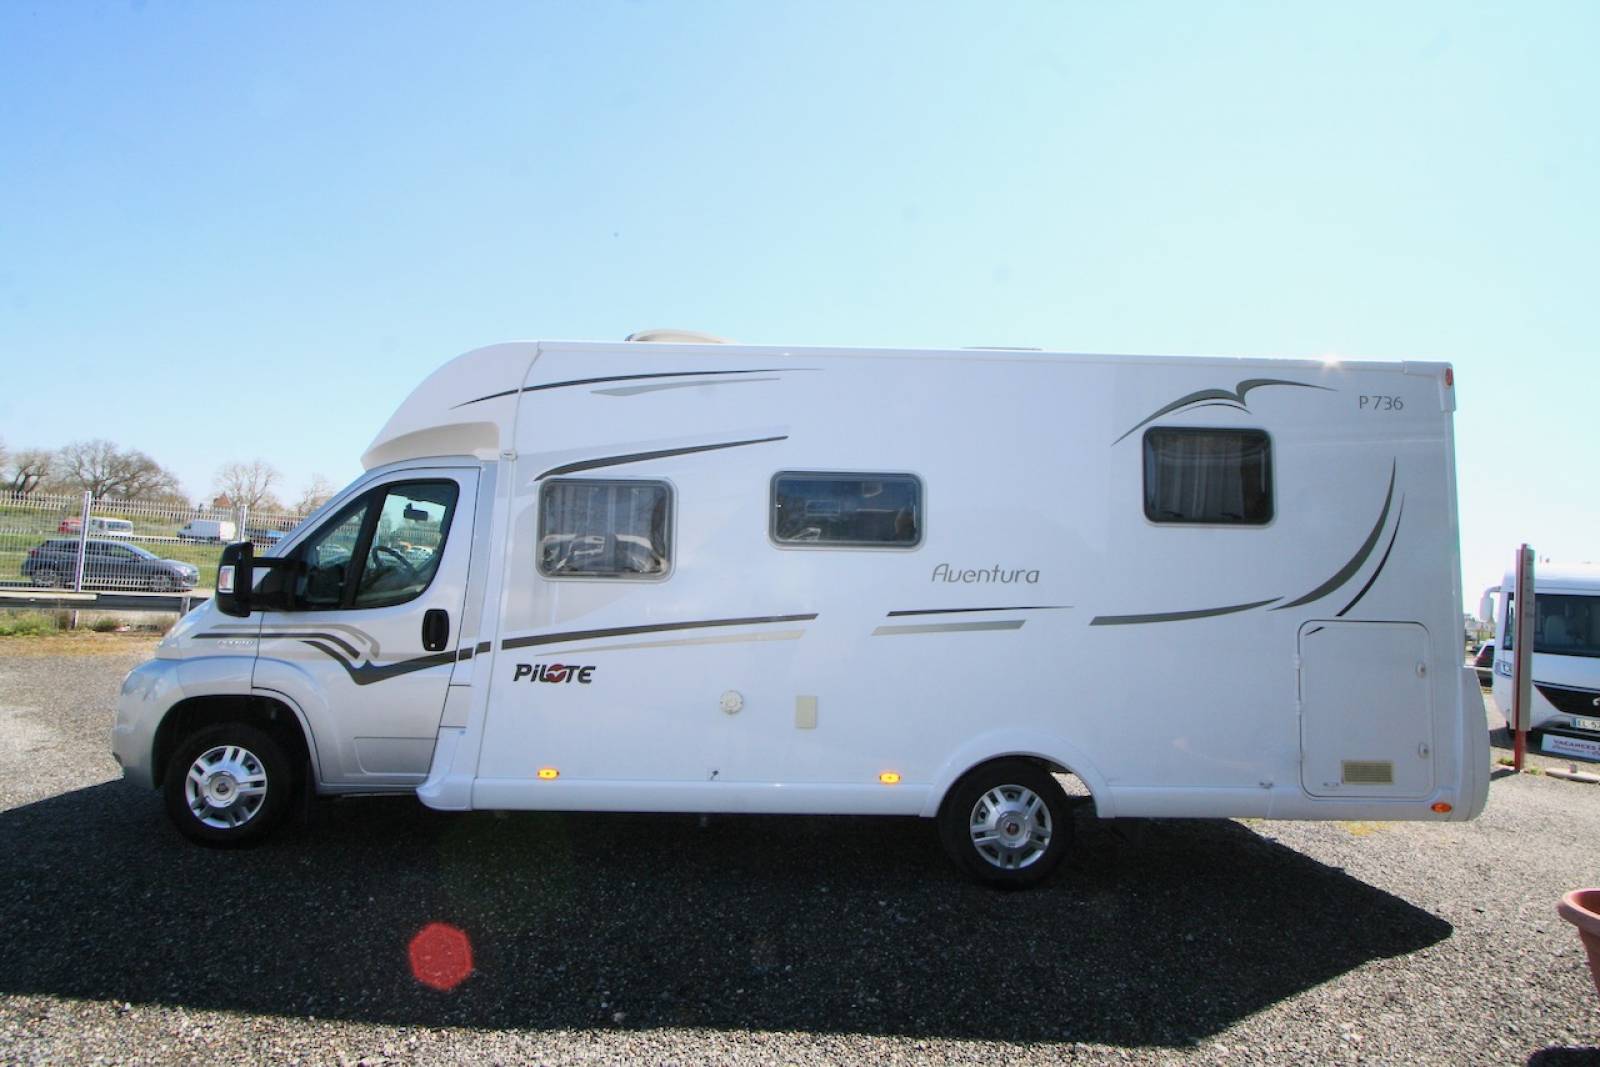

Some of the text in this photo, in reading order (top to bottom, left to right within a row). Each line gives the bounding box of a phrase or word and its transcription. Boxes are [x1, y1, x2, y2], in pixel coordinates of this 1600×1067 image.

[1359, 395, 1404, 411] P 736
[931, 562, 1041, 584] Aventura
